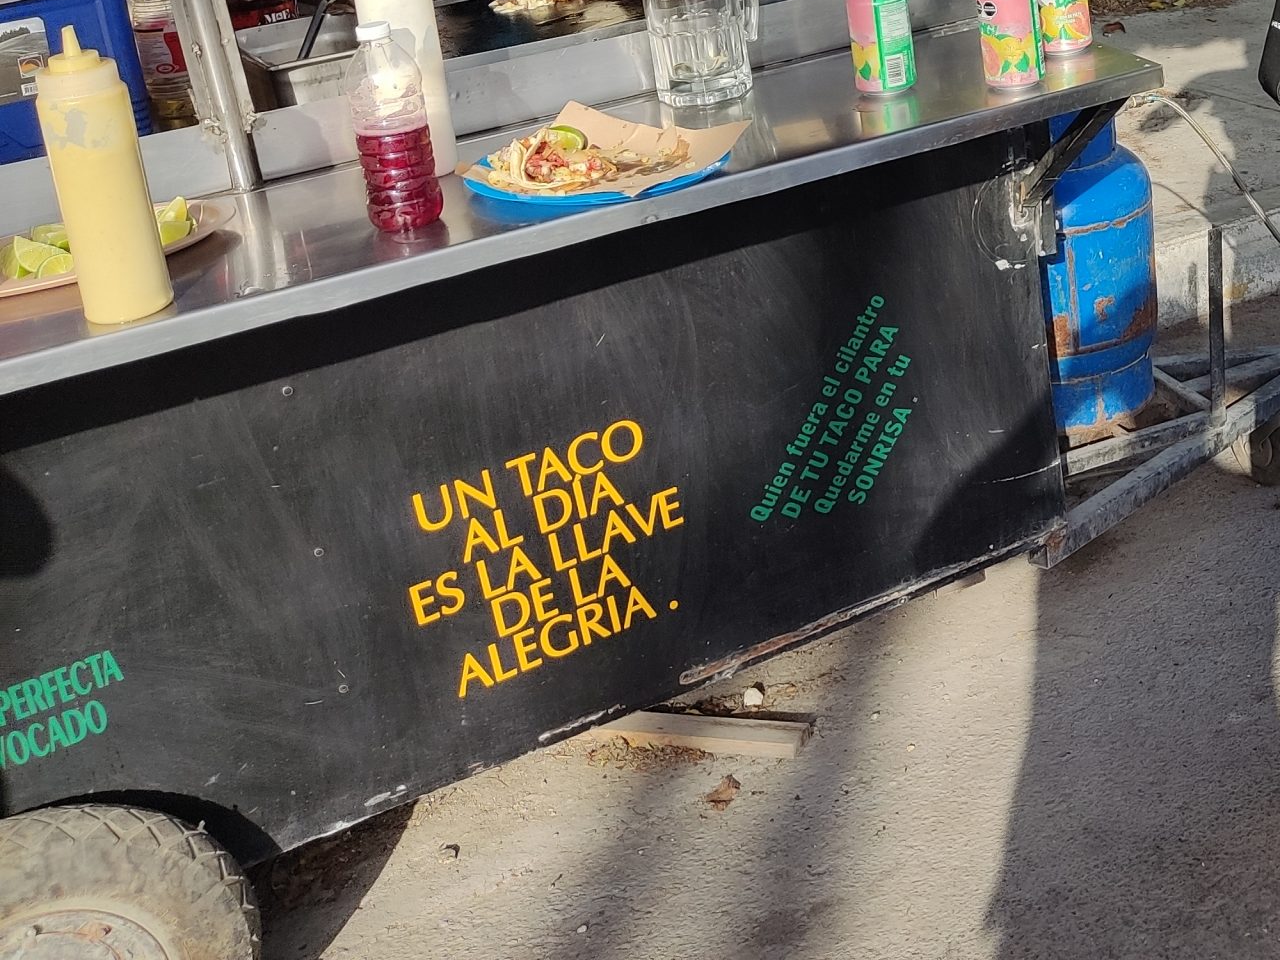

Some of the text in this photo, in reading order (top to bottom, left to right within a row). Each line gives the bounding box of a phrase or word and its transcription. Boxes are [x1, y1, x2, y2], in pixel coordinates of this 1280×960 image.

[750, 295, 885, 522] Quien fuera el cilantro
[781, 326, 899, 519] DE TU TACO PARA
[814, 354, 912, 514] Quedarme en tu
[848, 407, 912, 505] SONRISA
[411, 419, 644, 531] UN TACO
[463, 470, 625, 564] AL DÍA
[408, 486, 685, 626] ES LA LLAVE
[489, 553, 632, 638] DE LA
[0, 650, 124, 727] PERFECTA
